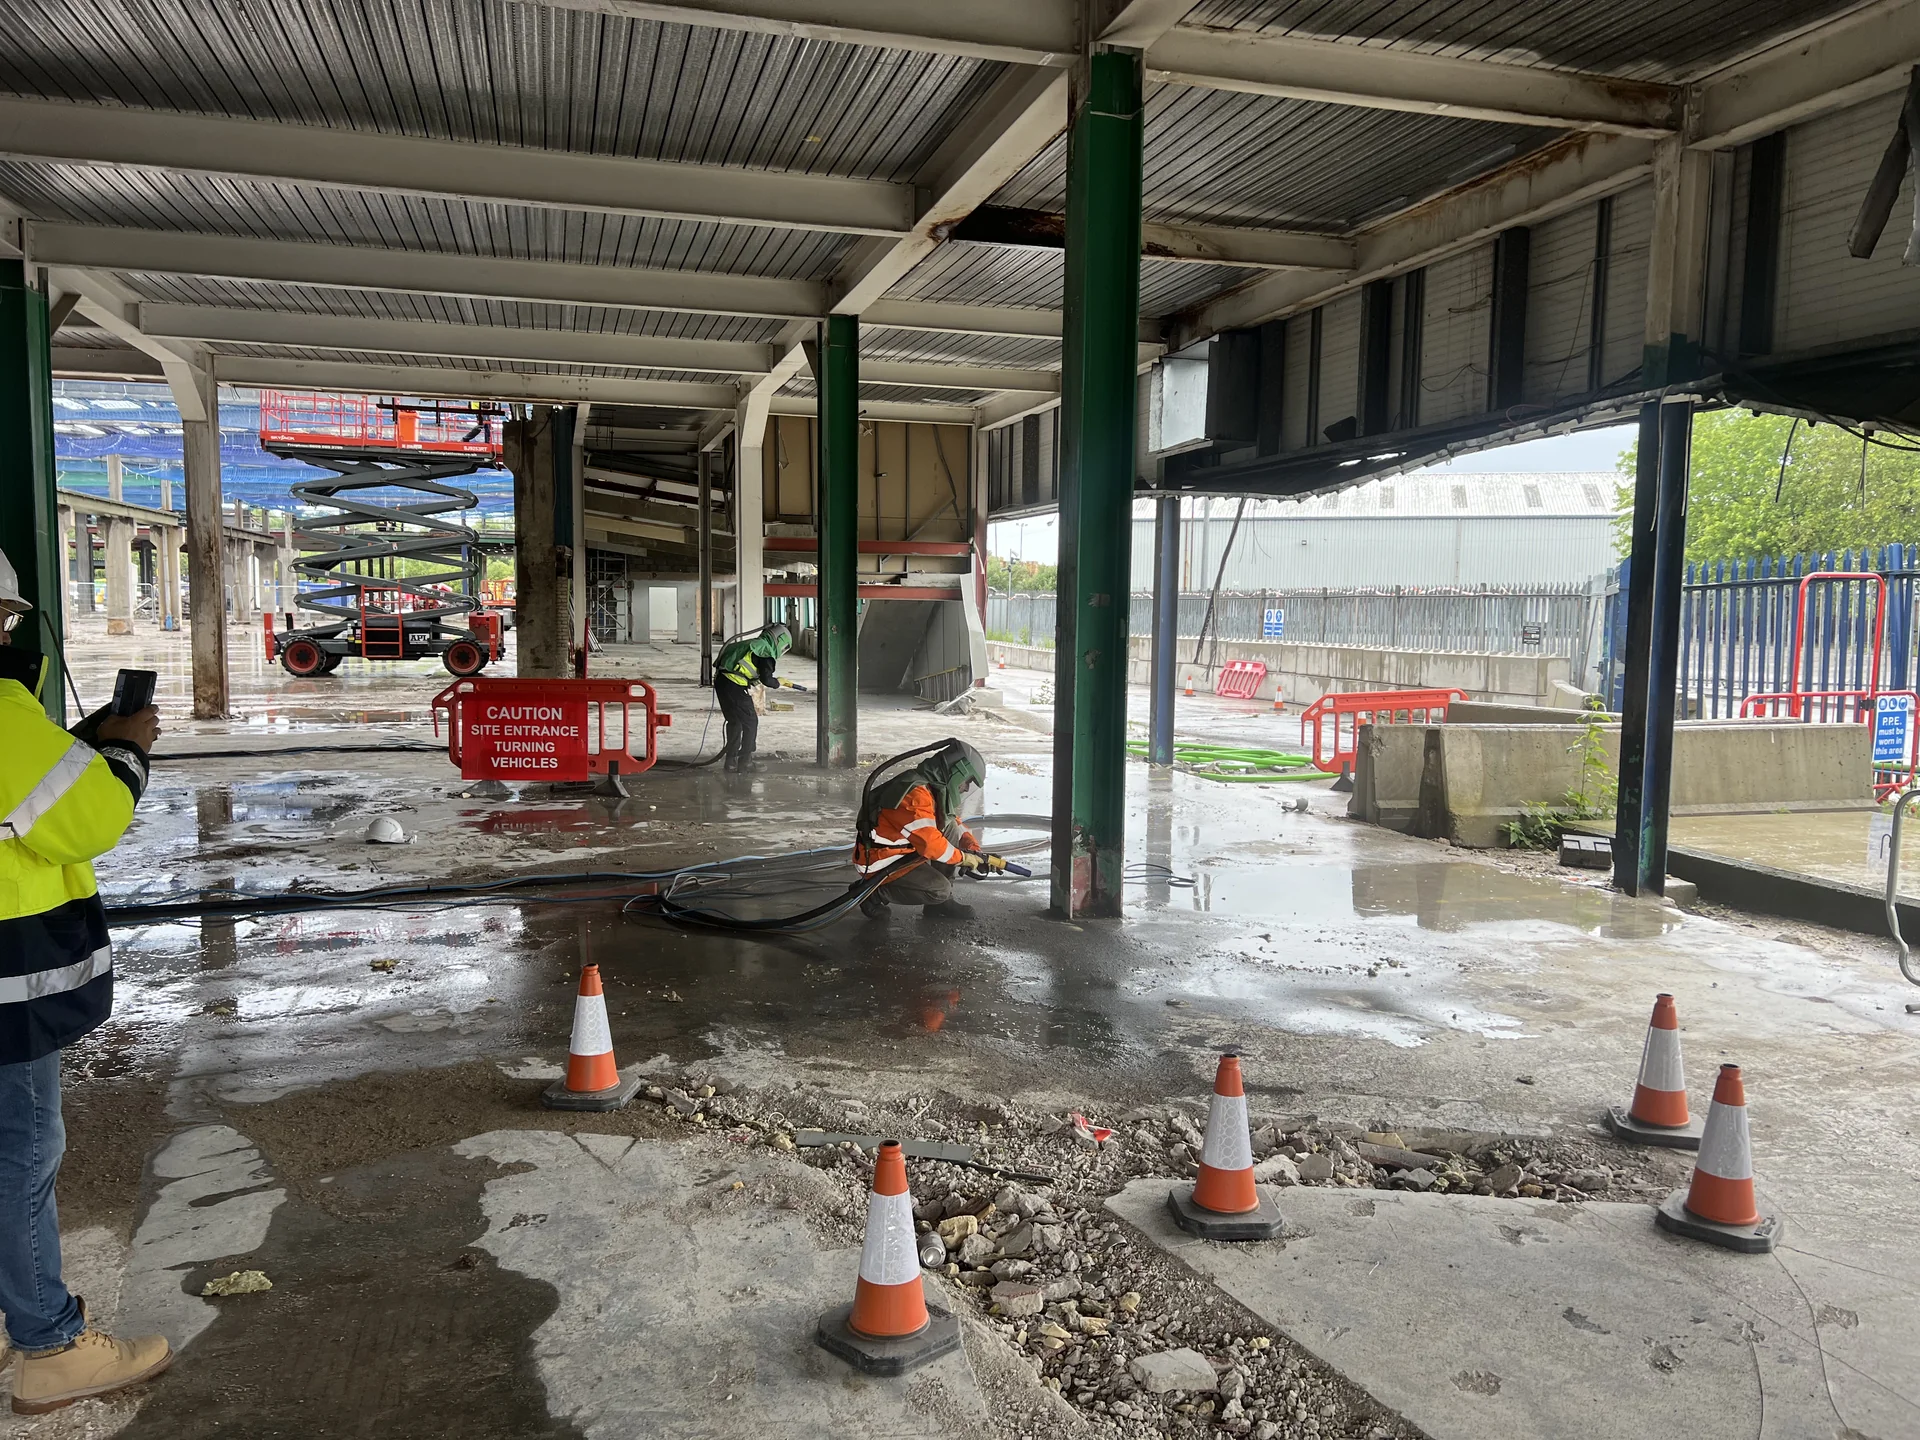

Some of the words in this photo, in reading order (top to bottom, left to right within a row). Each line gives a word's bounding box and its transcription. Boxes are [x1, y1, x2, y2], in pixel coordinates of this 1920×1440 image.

[486, 707, 562, 720] CAUTION
[1882, 717, 1902, 725] P.P.E.
[471, 725, 500, 736] SITE
[504, 725, 578, 737] ENTRANCE
[494, 742, 555, 752] TURNING
[1876, 747, 1887, 755] this
[491, 757, 558, 768] VEHICLES
